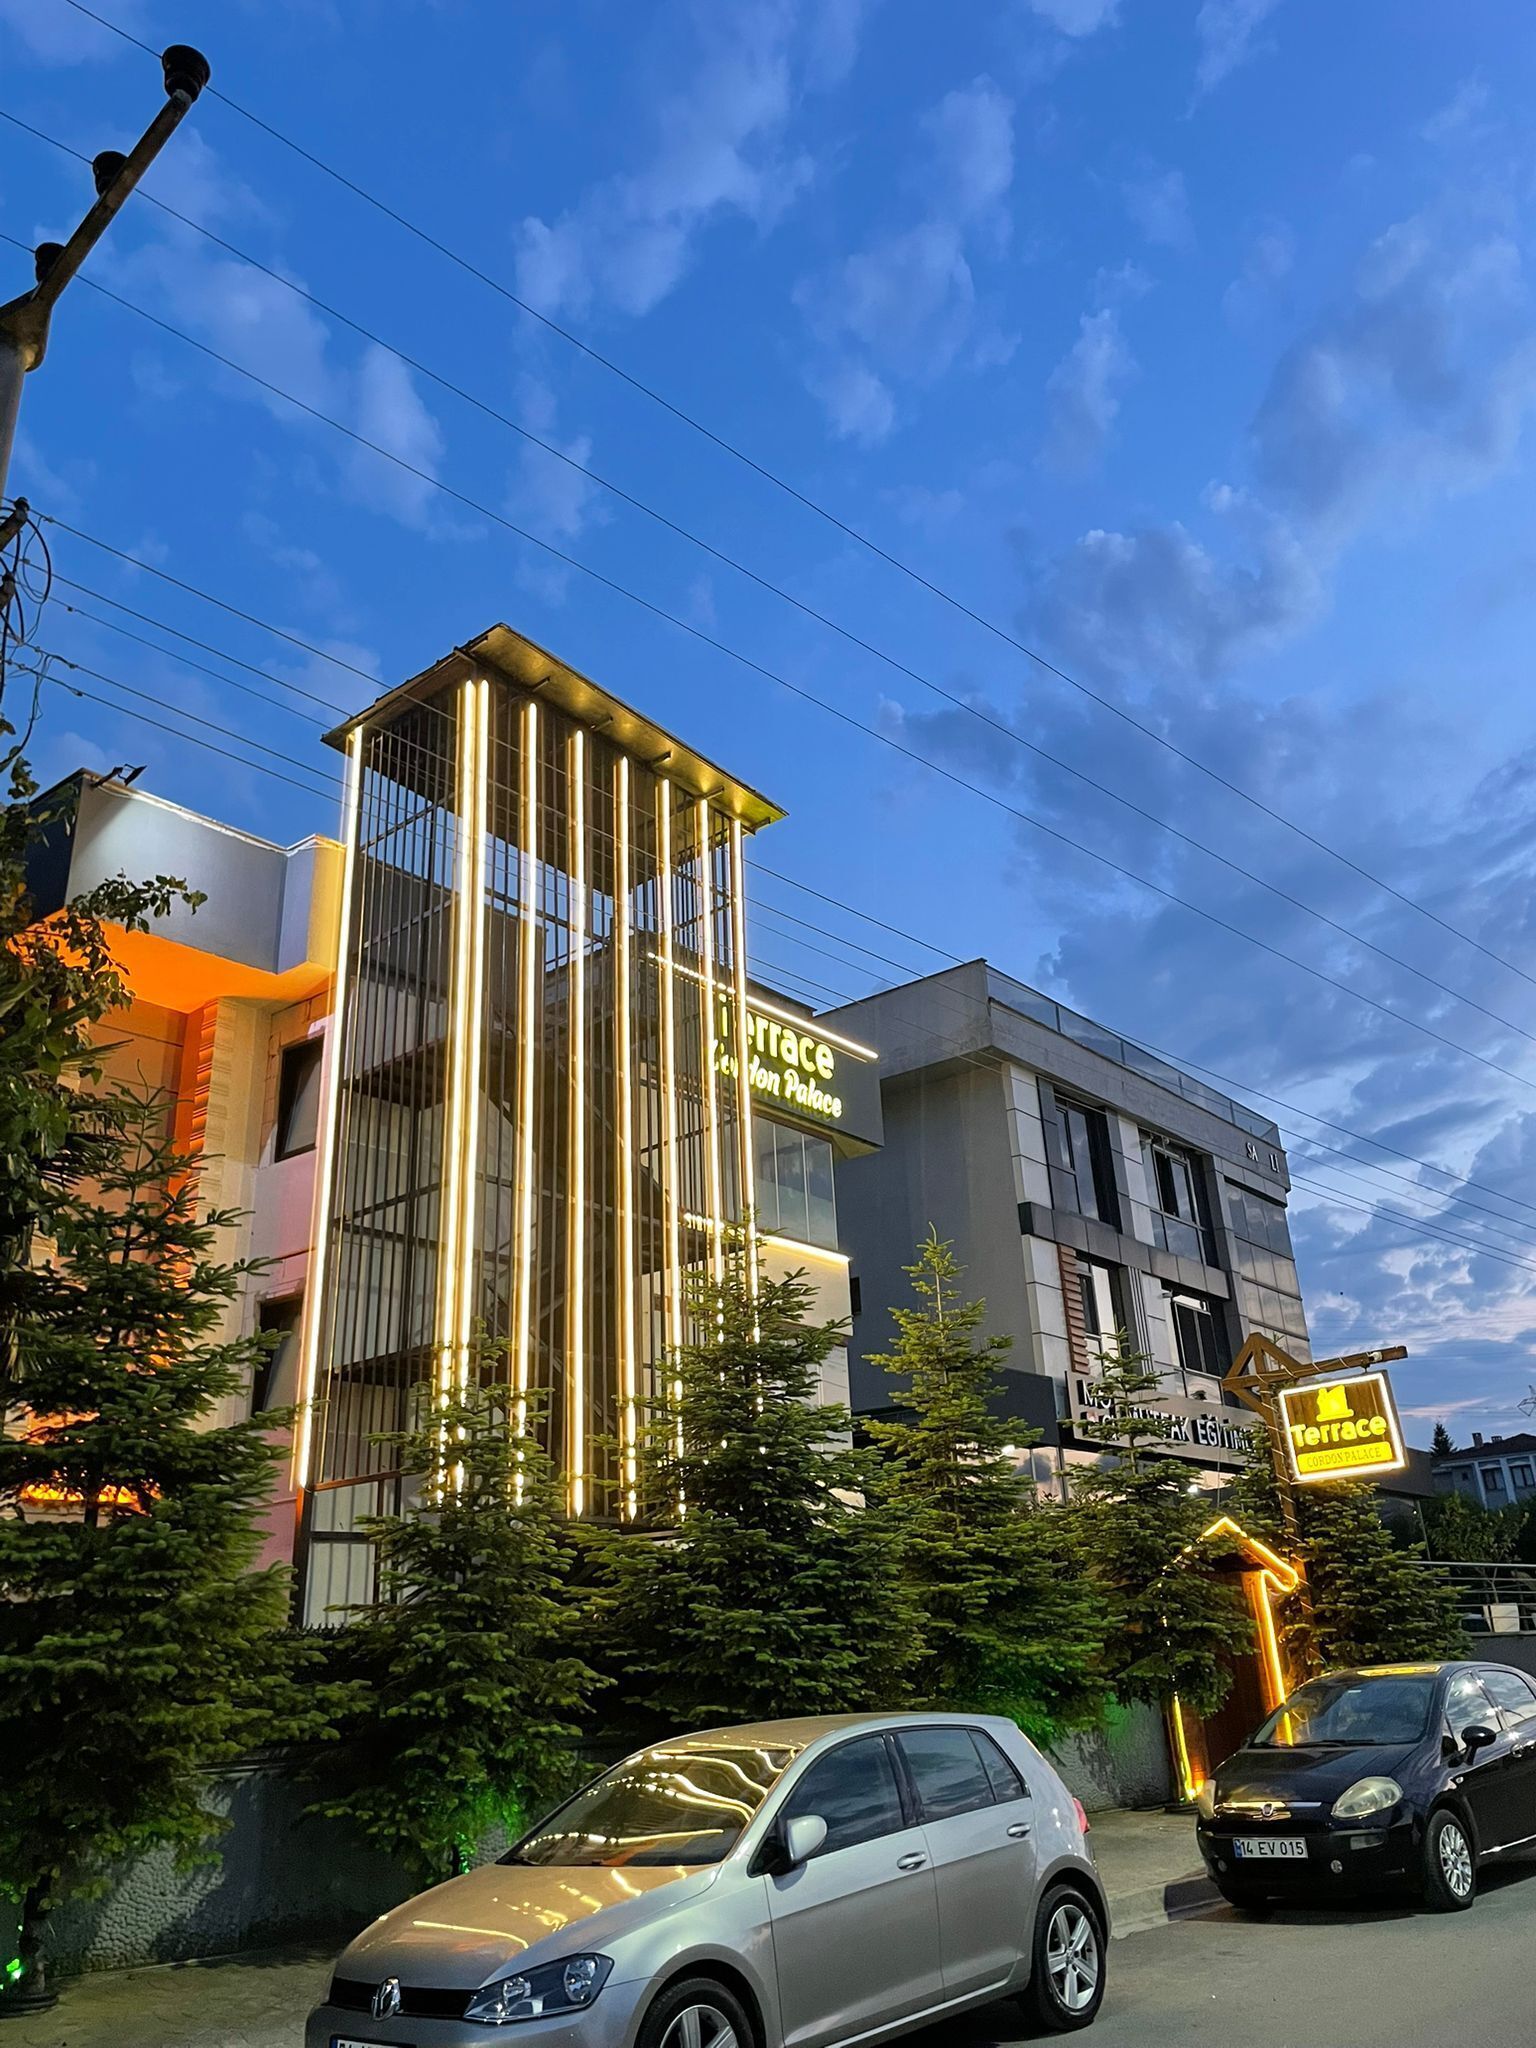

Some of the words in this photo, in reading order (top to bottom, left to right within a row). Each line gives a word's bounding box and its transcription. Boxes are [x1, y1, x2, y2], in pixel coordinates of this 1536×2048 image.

[784, 1068, 843, 1118] Palace
[1290, 1415, 1387, 1448] Terrace
[1306, 1452, 1344, 1468] CORDON
[1344, 1446, 1382, 1462] PALACE
[1241, 1841, 1254, 1856] 14
[1258, 1841, 1275, 1856] EV
[1280, 1841, 1304, 1856] 015
